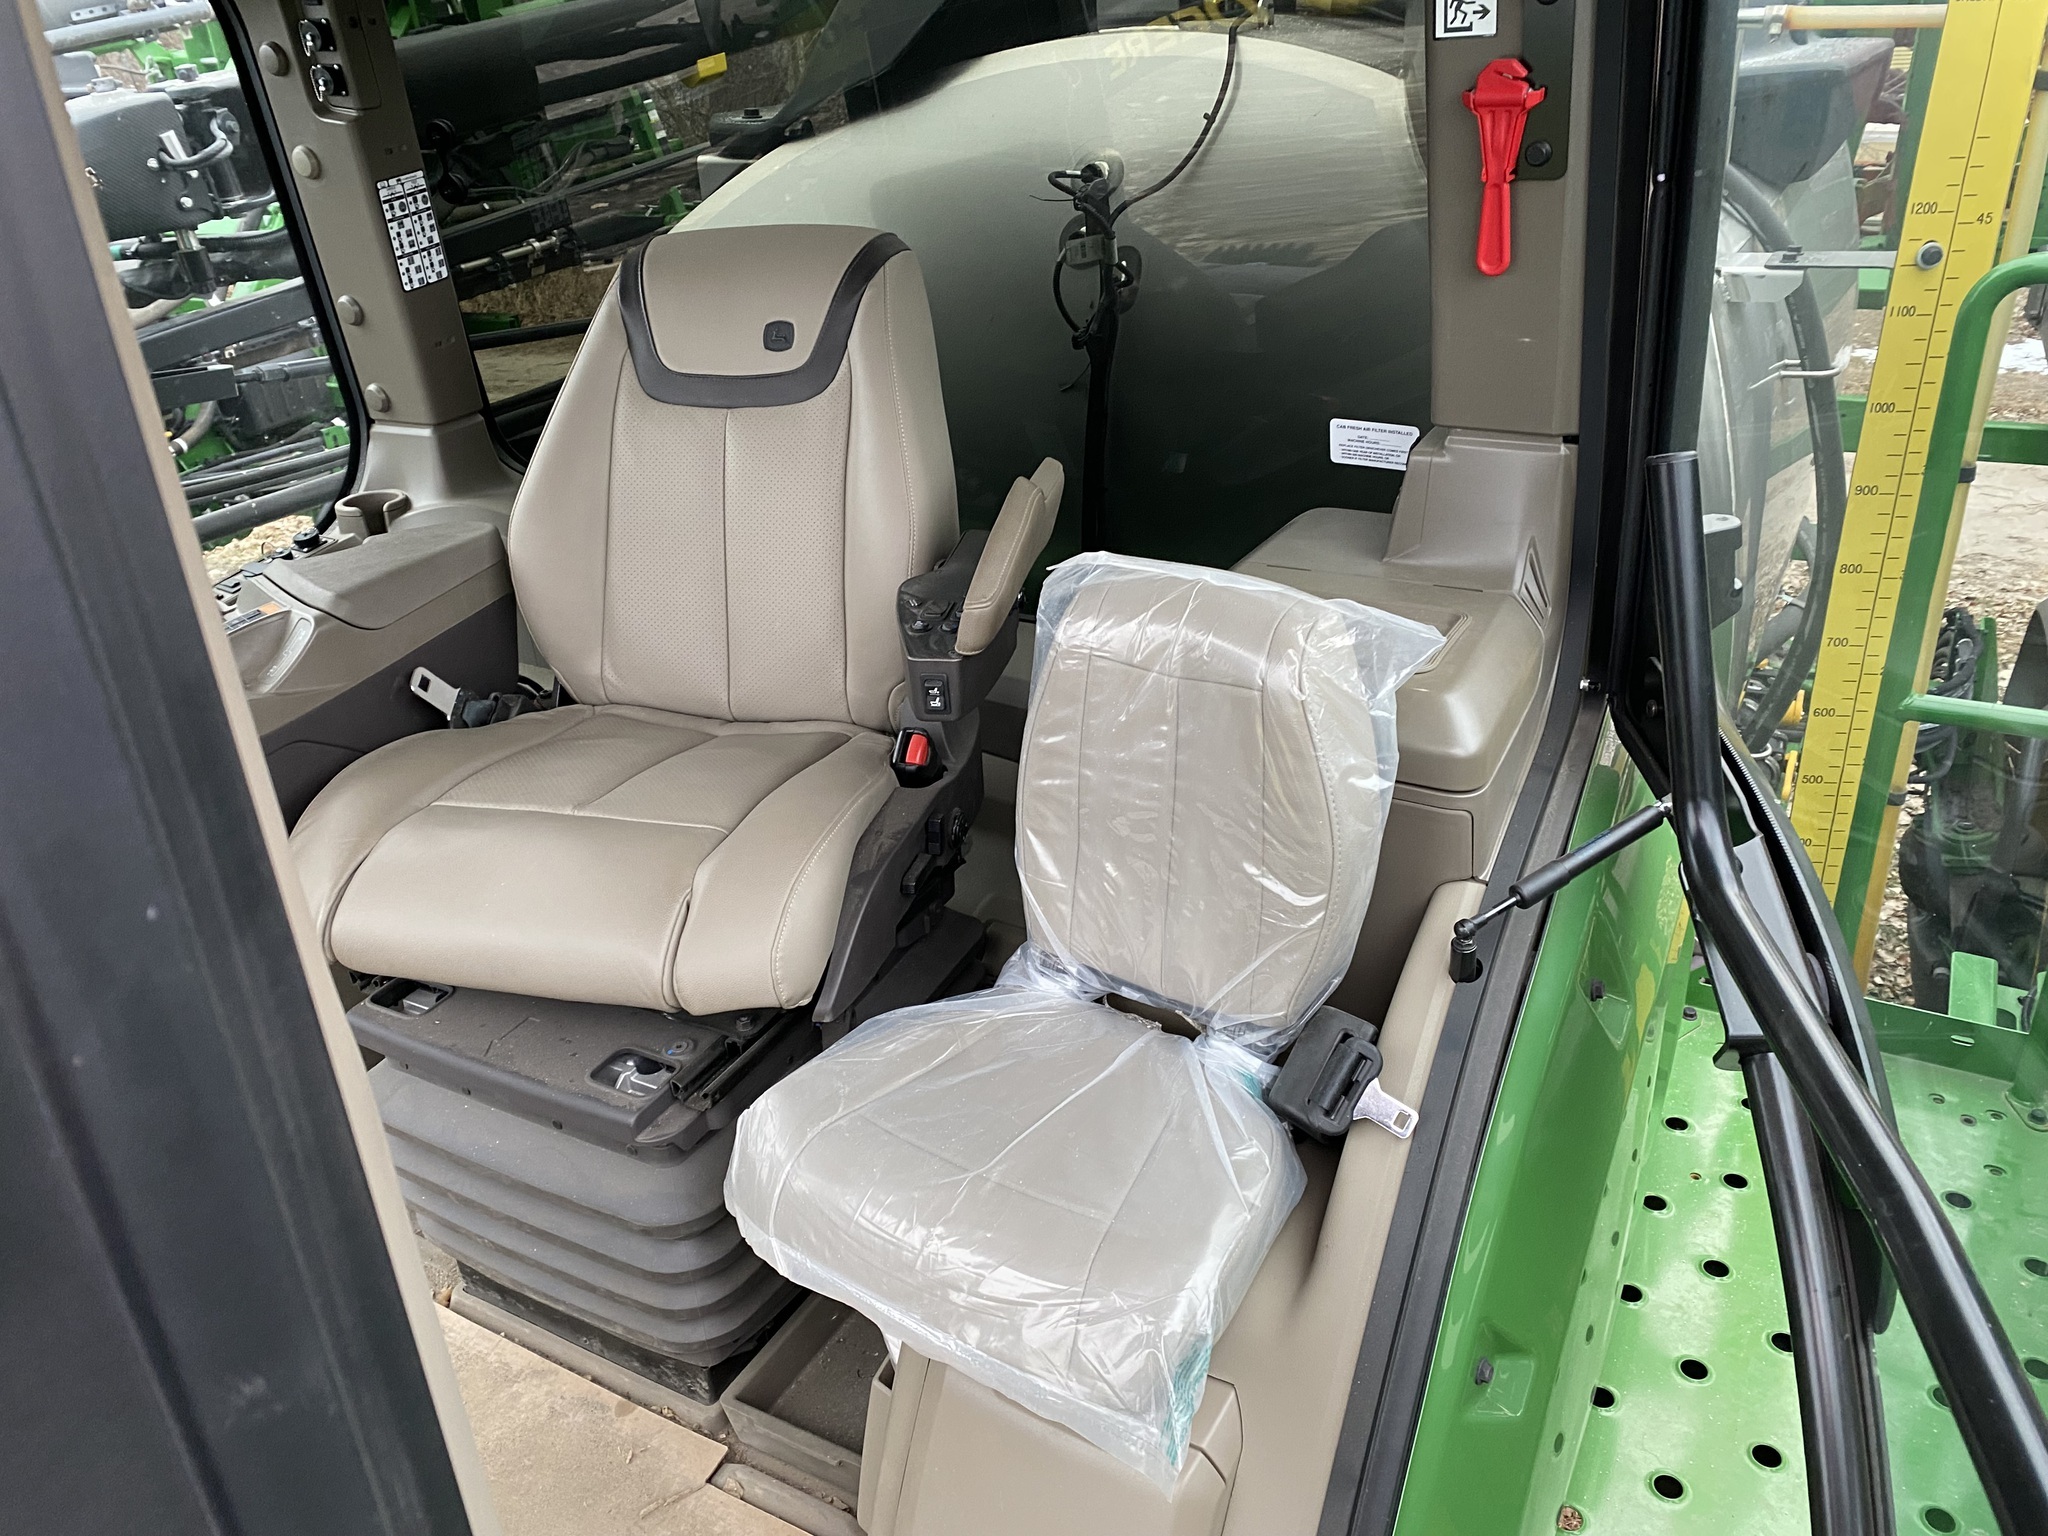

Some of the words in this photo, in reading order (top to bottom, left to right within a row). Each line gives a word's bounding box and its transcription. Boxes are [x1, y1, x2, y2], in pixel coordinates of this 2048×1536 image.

[1910, 201, 1938, 216] 1200
[1976, 211, 1994, 225] 45
[1889, 304, 1916, 318] 1100
[1869, 402, 1896, 415] 1000
[1388, 429, 1414, 437] INSTALLED
[1855, 485, 1879, 497] 900
[1839, 563, 1863, 575] 800
[1826, 637, 1849, 649] 700
[1813, 707, 1836, 719] 600
[1801, 775, 1824, 784] 500
